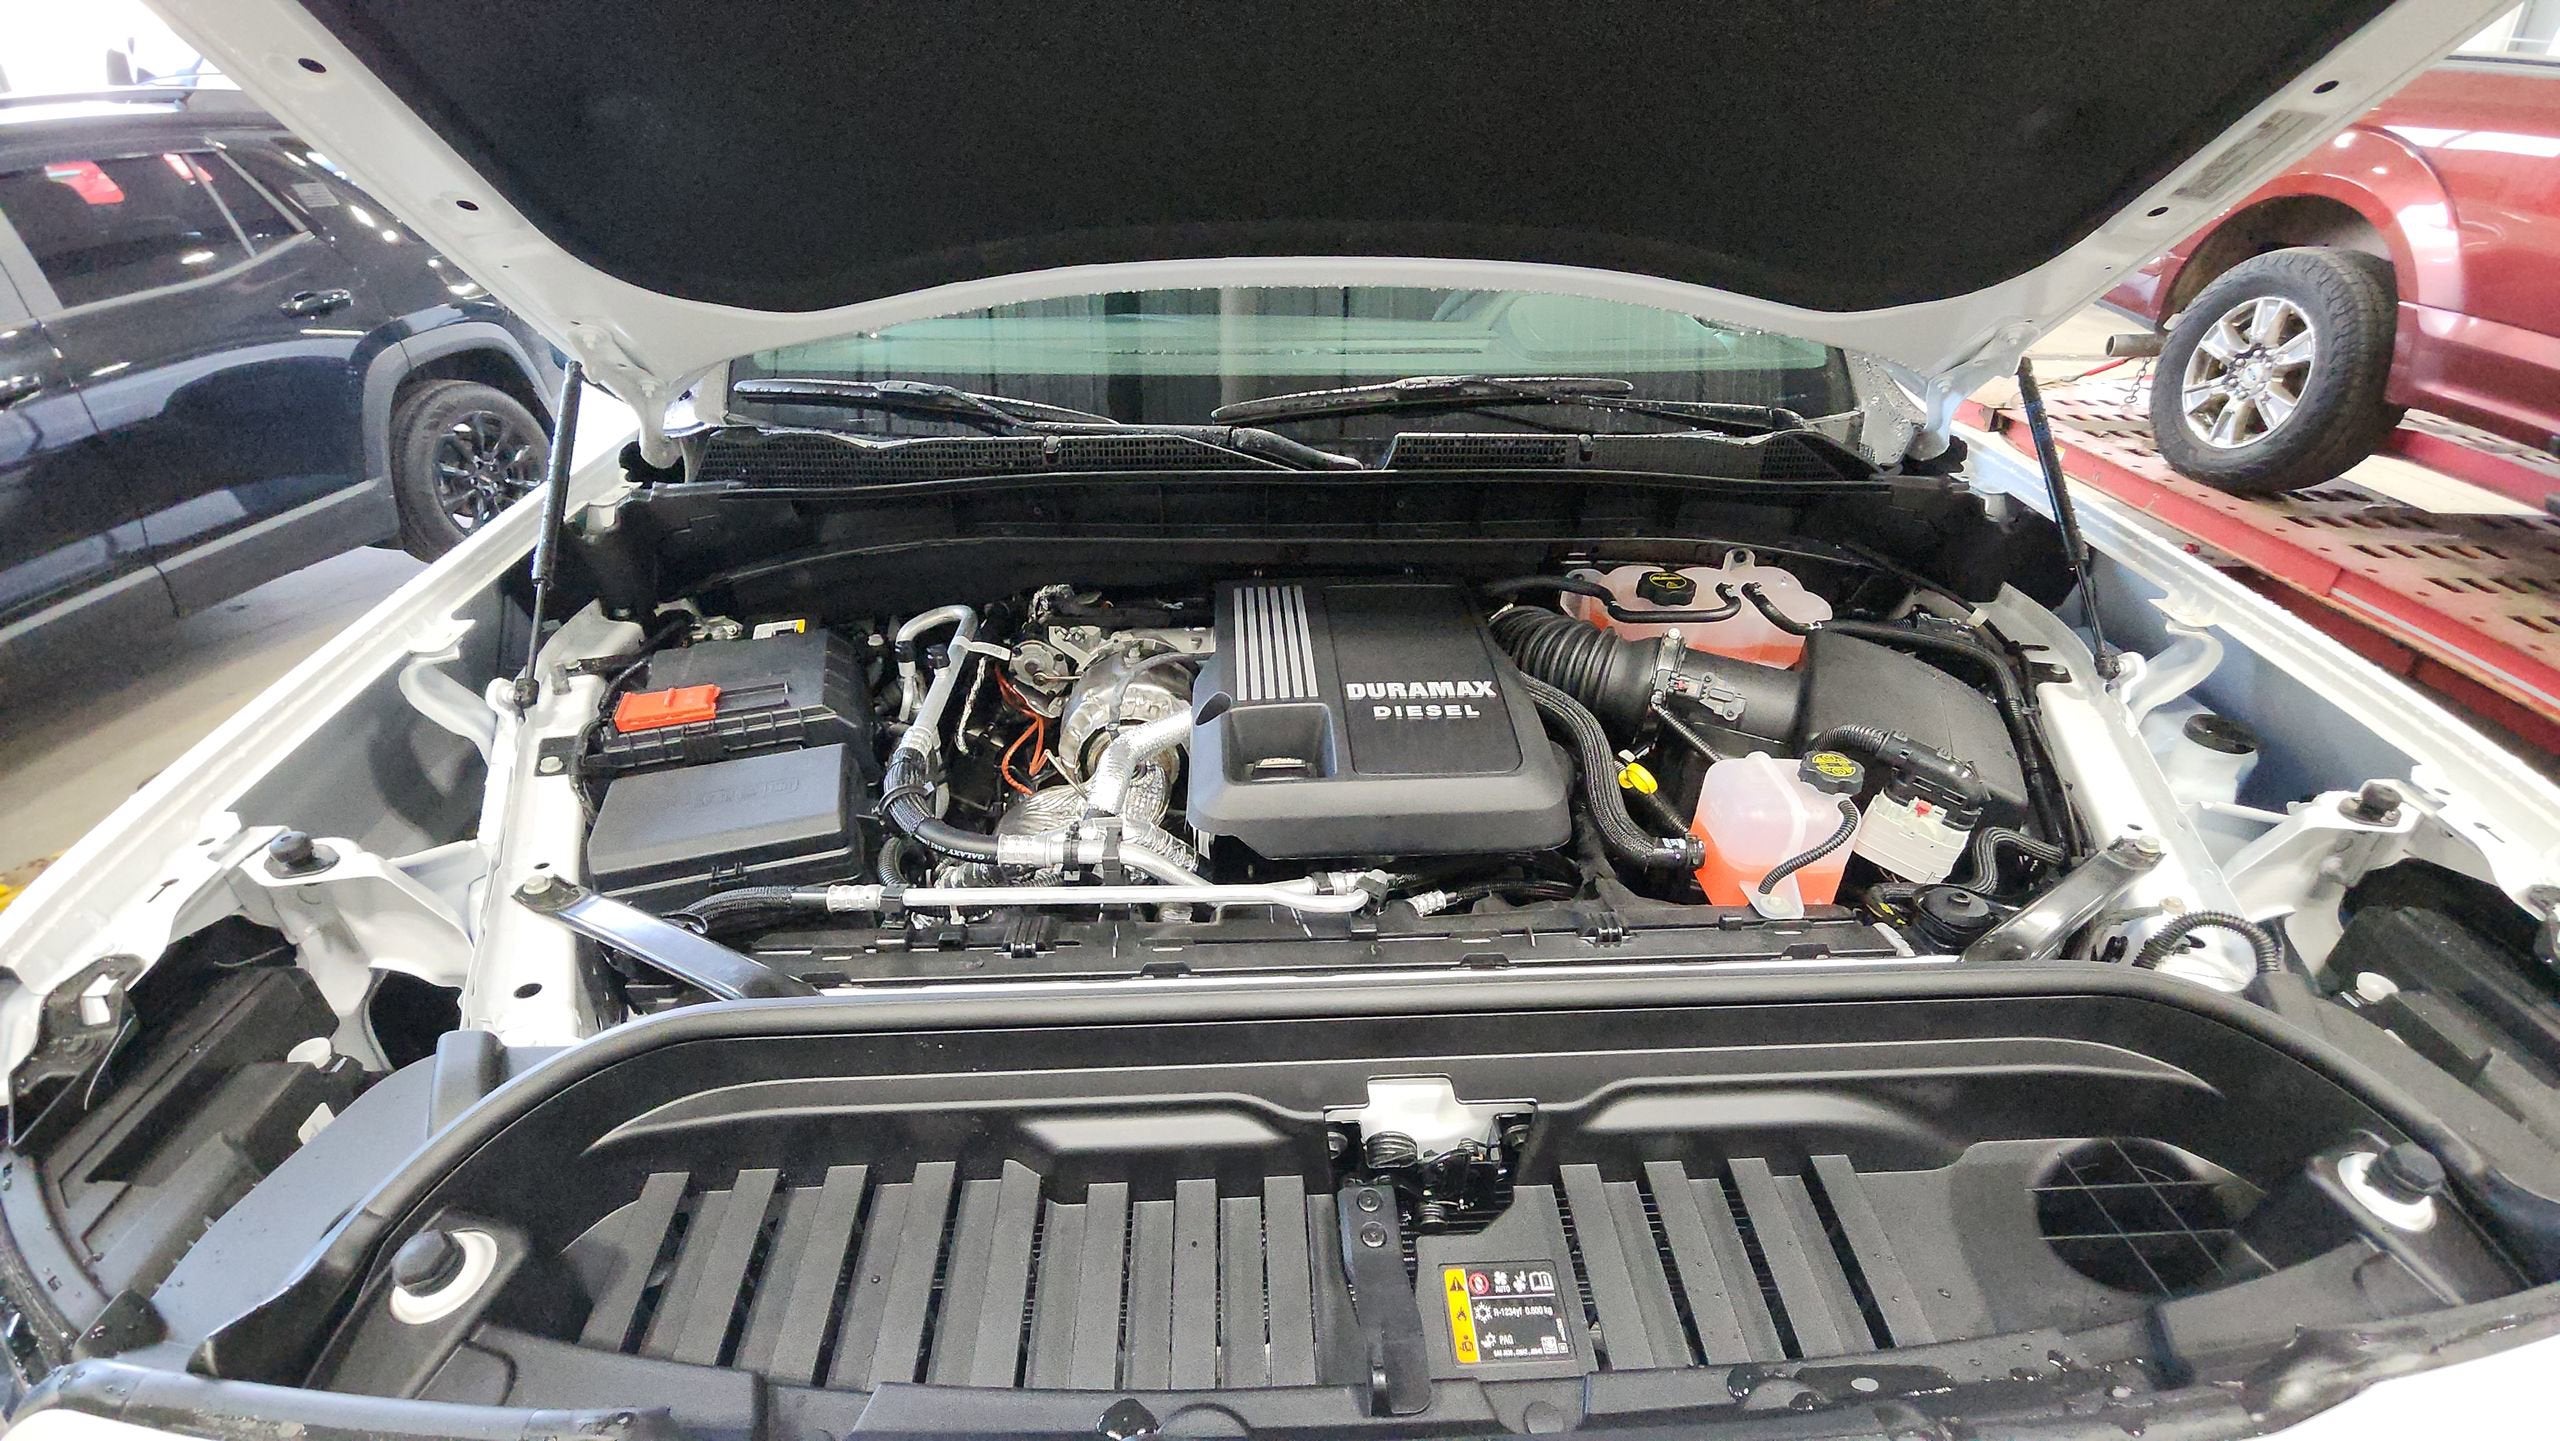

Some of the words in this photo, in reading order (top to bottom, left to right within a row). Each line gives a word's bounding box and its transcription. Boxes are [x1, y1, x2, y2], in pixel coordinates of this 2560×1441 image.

[1345, 681, 1497, 700] DURAMAX
[1372, 704, 1481, 720] DIESEL
[947, 848, 985, 860] GALAXY
[1495, 1285, 1511, 1294] AUTO
[1543, 1305, 1554, 1316] kg
